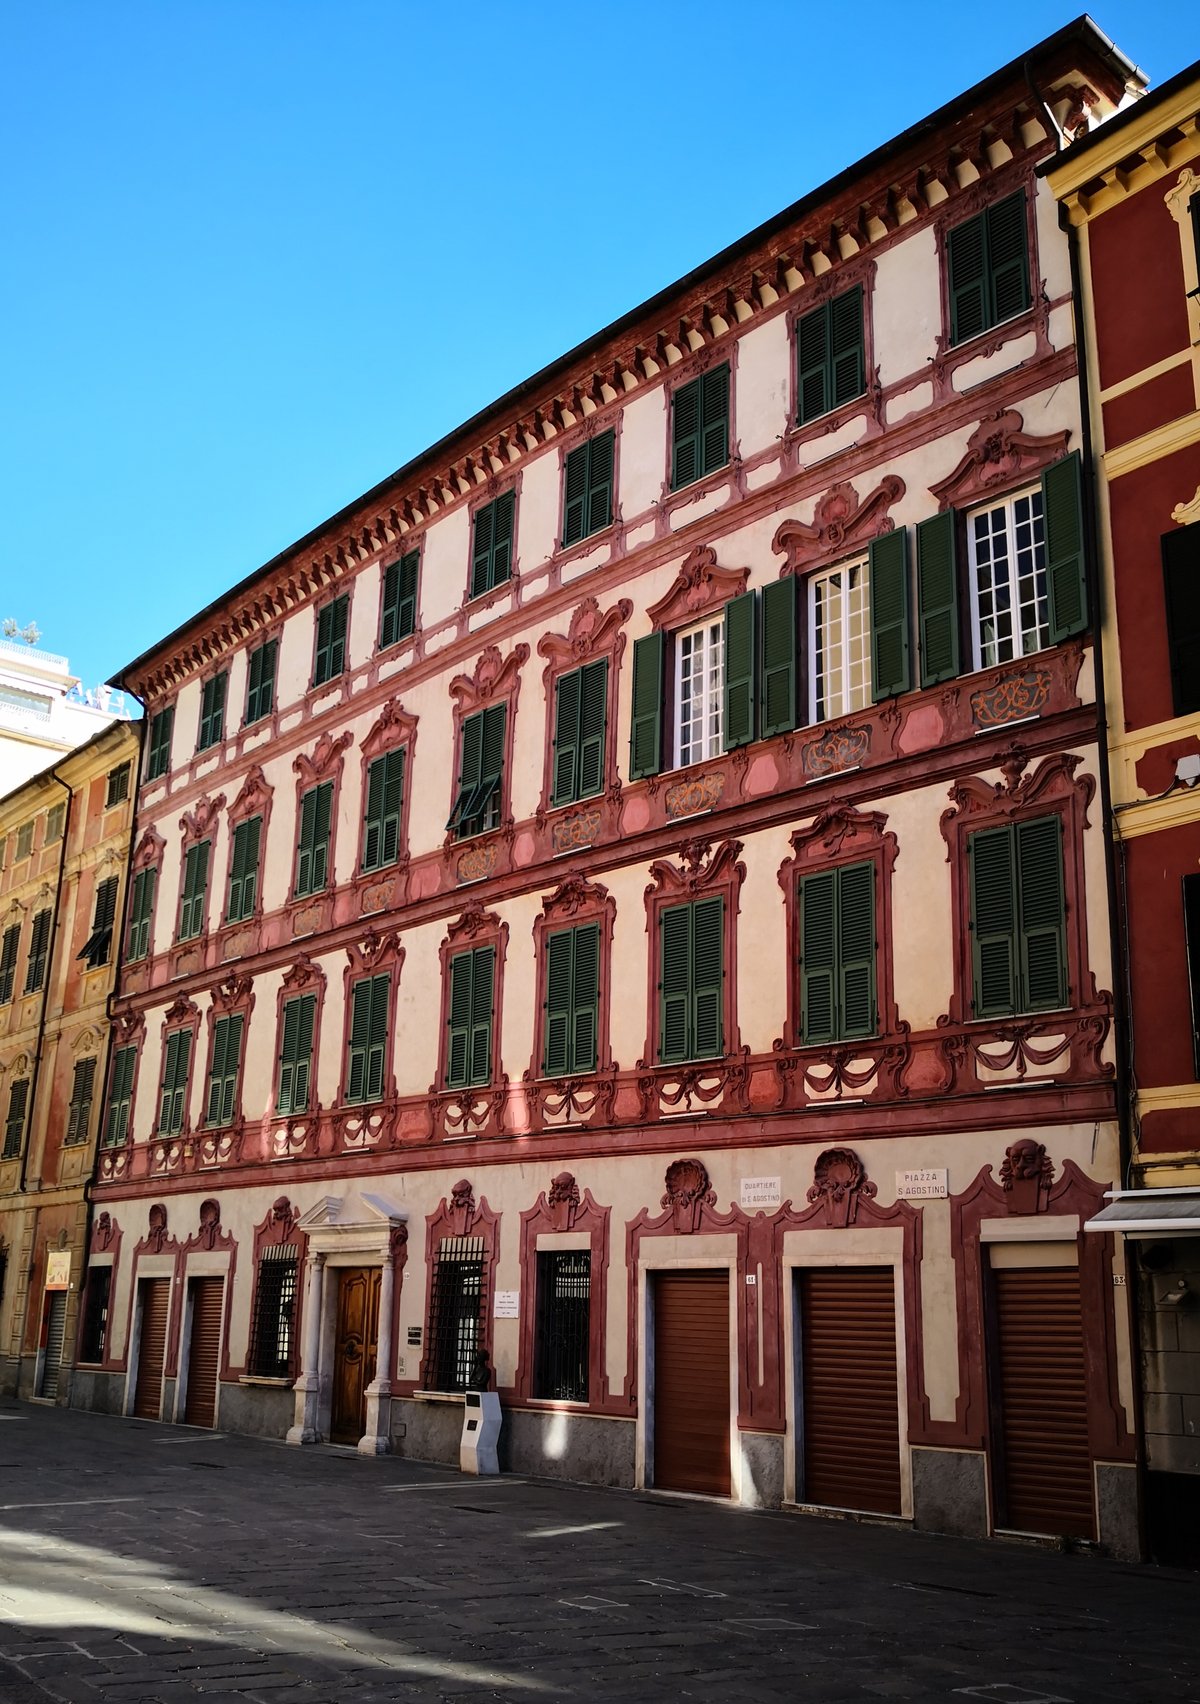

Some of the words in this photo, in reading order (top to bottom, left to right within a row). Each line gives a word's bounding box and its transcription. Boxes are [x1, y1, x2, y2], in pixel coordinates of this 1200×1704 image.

[744, 1181, 777, 1190] QUARTIERE
[905, 1185, 945, 1195] AGOSTINO
[752, 1193, 780, 1202] AGOSTINO
